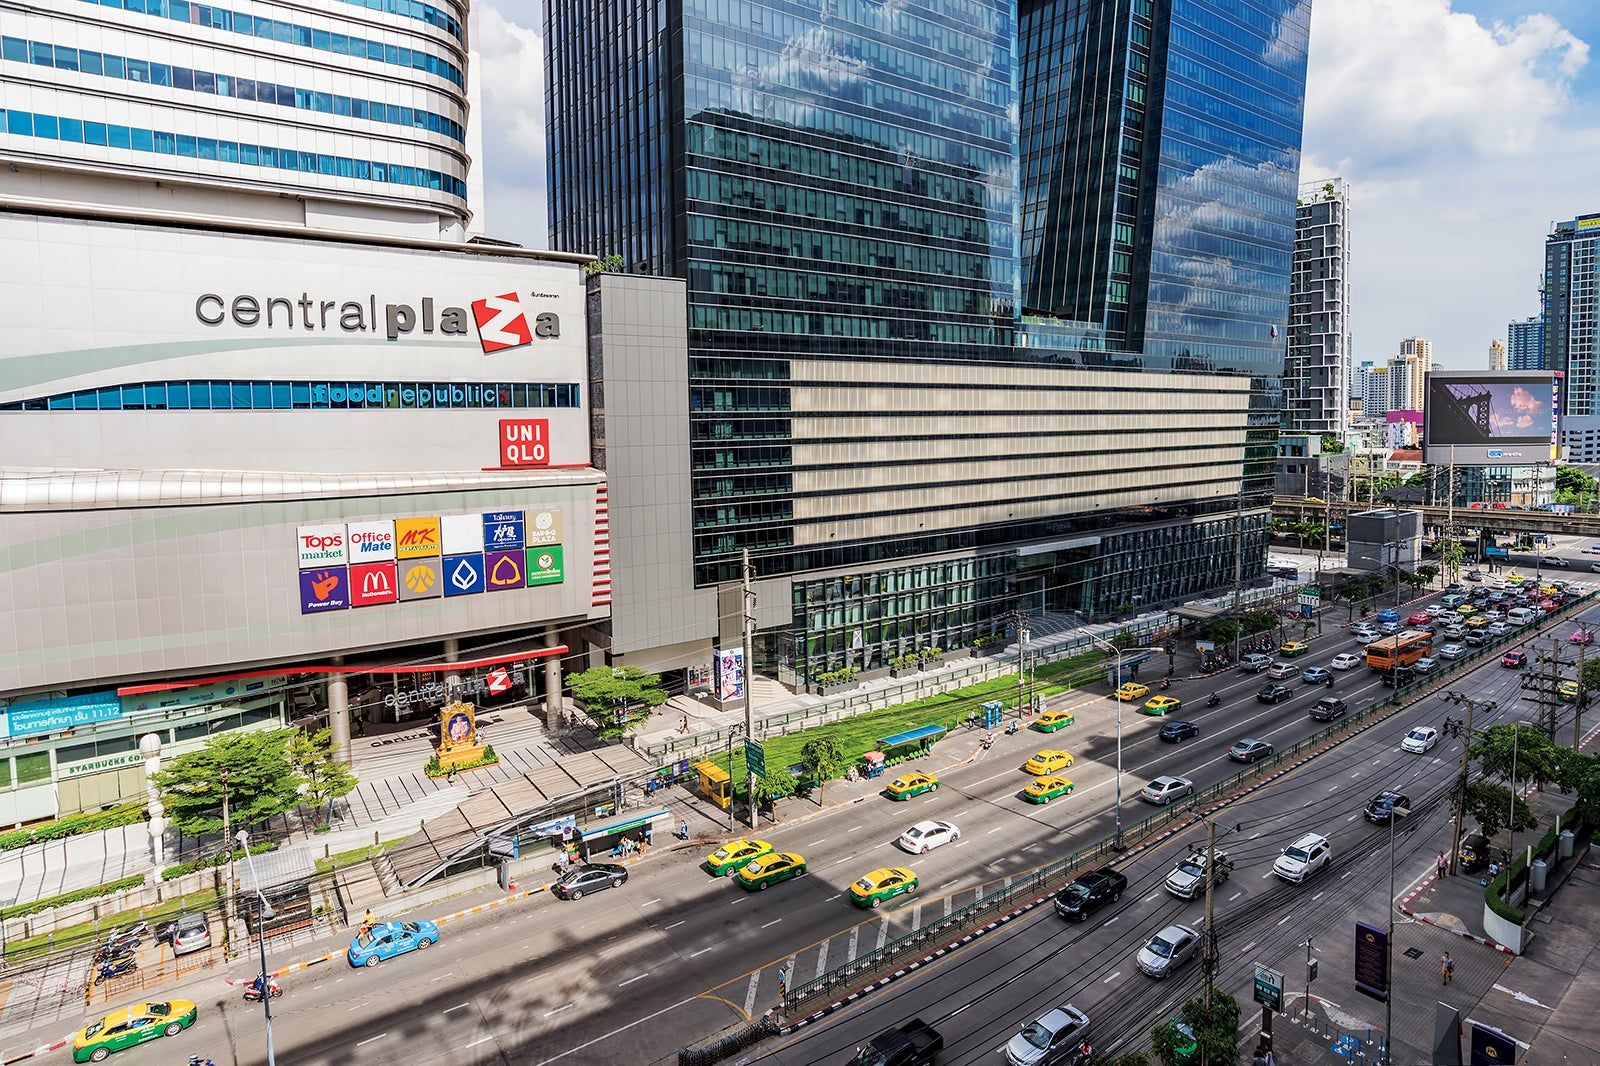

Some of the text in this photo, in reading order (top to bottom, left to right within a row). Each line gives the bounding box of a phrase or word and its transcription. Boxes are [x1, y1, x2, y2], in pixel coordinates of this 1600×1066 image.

[506, 424, 541, 442] UNI
[506, 443, 545, 465] QLO
[300, 535, 342, 551] Tops
[351, 532, 391, 544] Office
[399, 527, 436, 546] MK
[301, 549, 343, 560] market
[360, 541, 392, 553] Mate
[69, 756, 125, 774] STARBUCKS
